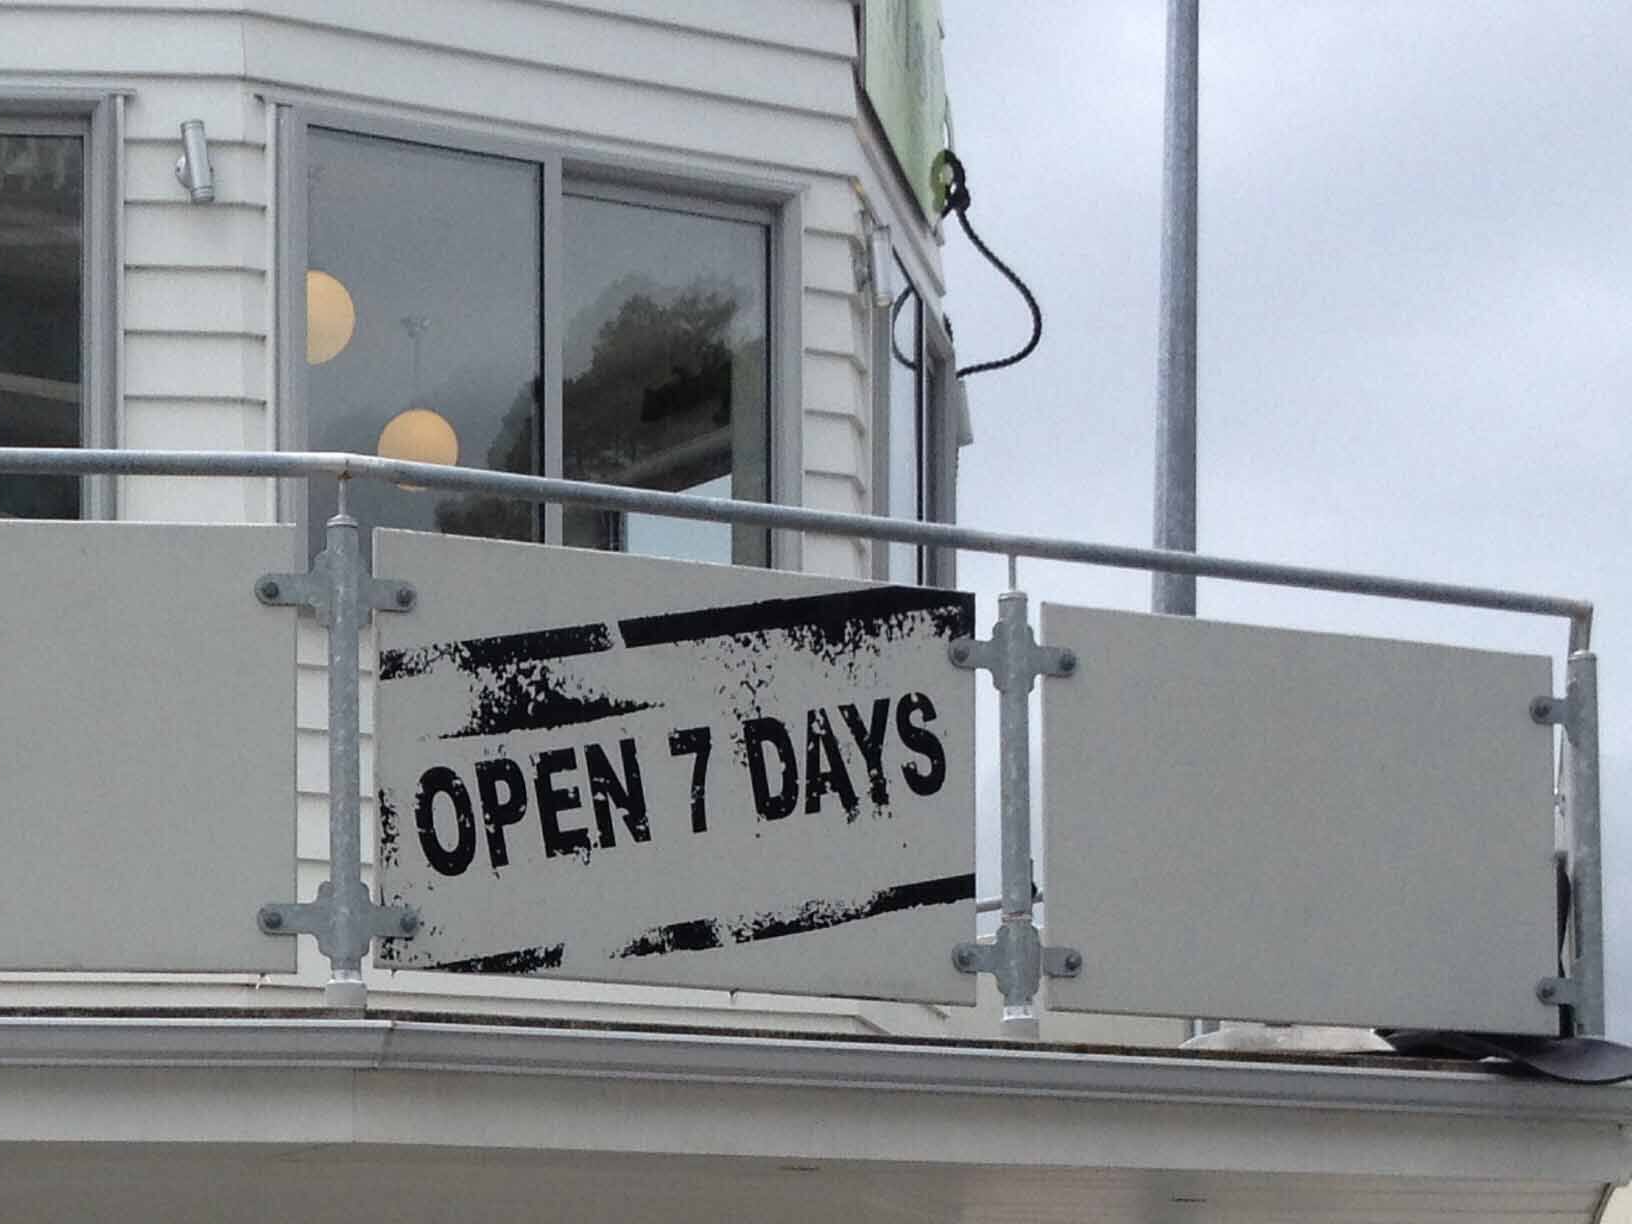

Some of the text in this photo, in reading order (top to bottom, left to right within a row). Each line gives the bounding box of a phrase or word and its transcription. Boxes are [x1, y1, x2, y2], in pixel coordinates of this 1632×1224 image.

[414, 692, 947, 877] OPEN 7 DAYS
